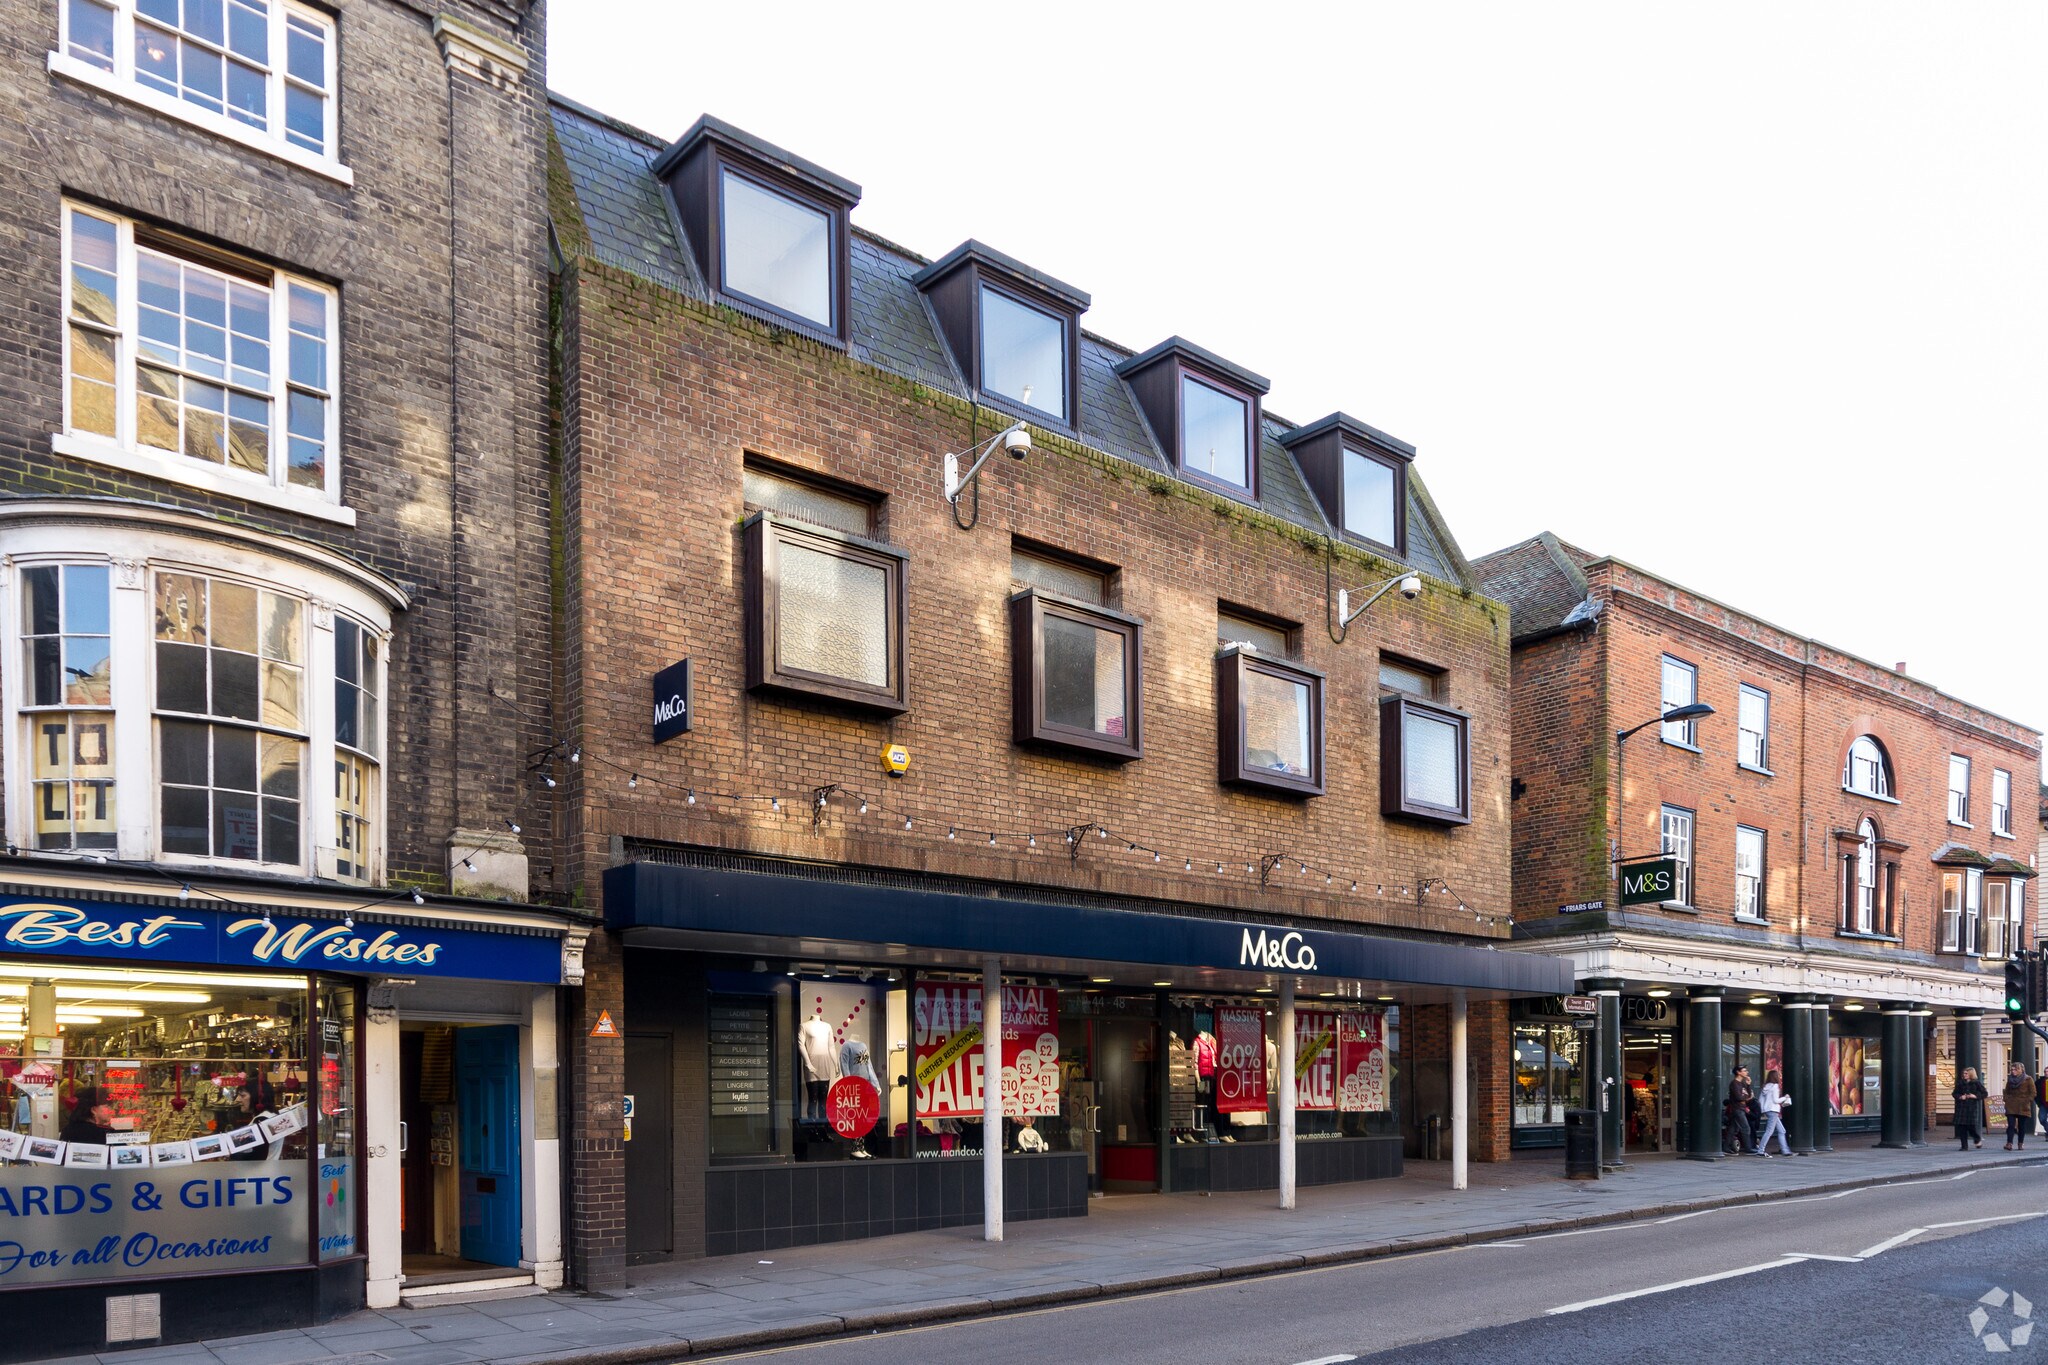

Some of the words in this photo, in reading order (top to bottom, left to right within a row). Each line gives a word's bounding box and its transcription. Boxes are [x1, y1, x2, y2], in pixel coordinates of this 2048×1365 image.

[654, 694, 686, 725] M&Co.
[42, 723, 108, 765] TO
[43, 778, 114, 820] LET
[1624, 871, 1670, 895] M&S
[1565, 903, 1587, 913] FRIARS
[1587, 901, 1603, 910] GATE
[0, 903, 206, 949] Best
[225, 918, 443, 966] Wishes
[1240, 927, 1318, 971] M&Co.
[1001, 987, 1048, 1013] INAL
[1220, 1009, 1261, 1022] MASSIVE
[1627, 998, 1668, 1020] FOOD
[1001, 1013, 1048, 1026] EARANCE
[1341, 1014, 1377, 1033] FINAL
[918, 1056, 945, 1081] FURTHER
[942, 1026, 979, 1060] REDUCTIONS
[1040, 1045, 1053, 1057] £2
[1220, 1044, 1261, 1069] 60%
[1019, 1063, 1032, 1075] £5
[916, 1054, 984, 1113] SALE
[1001, 1080, 1018, 1092] £10
[1041, 1075, 1052, 1087] £1
[1220, 1070, 1261, 1098] OFF
[732, 1092, 750, 1102] kylie
[835, 1084, 861, 1097] KYLIE
[1022, 1092, 1035, 1105] £5
[733, 1105, 748, 1113] KIDS
[836, 1096, 861, 1109] SALE
[836, 1107, 869, 1120] NOW
[836, 1120, 855, 1132] ON
[915, 1145, 984, 1159] www.mandco.c
[321, 1164, 349, 1178] Best
[131, 1181, 163, 1211] &
[179, 1176, 293, 1209] GIFTS
[319, 1234, 356, 1252] Wishes
[0, 1240, 68, 1276] For
[71, 1235, 122, 1266] all
[122, 1231, 273, 1267] Occasions
